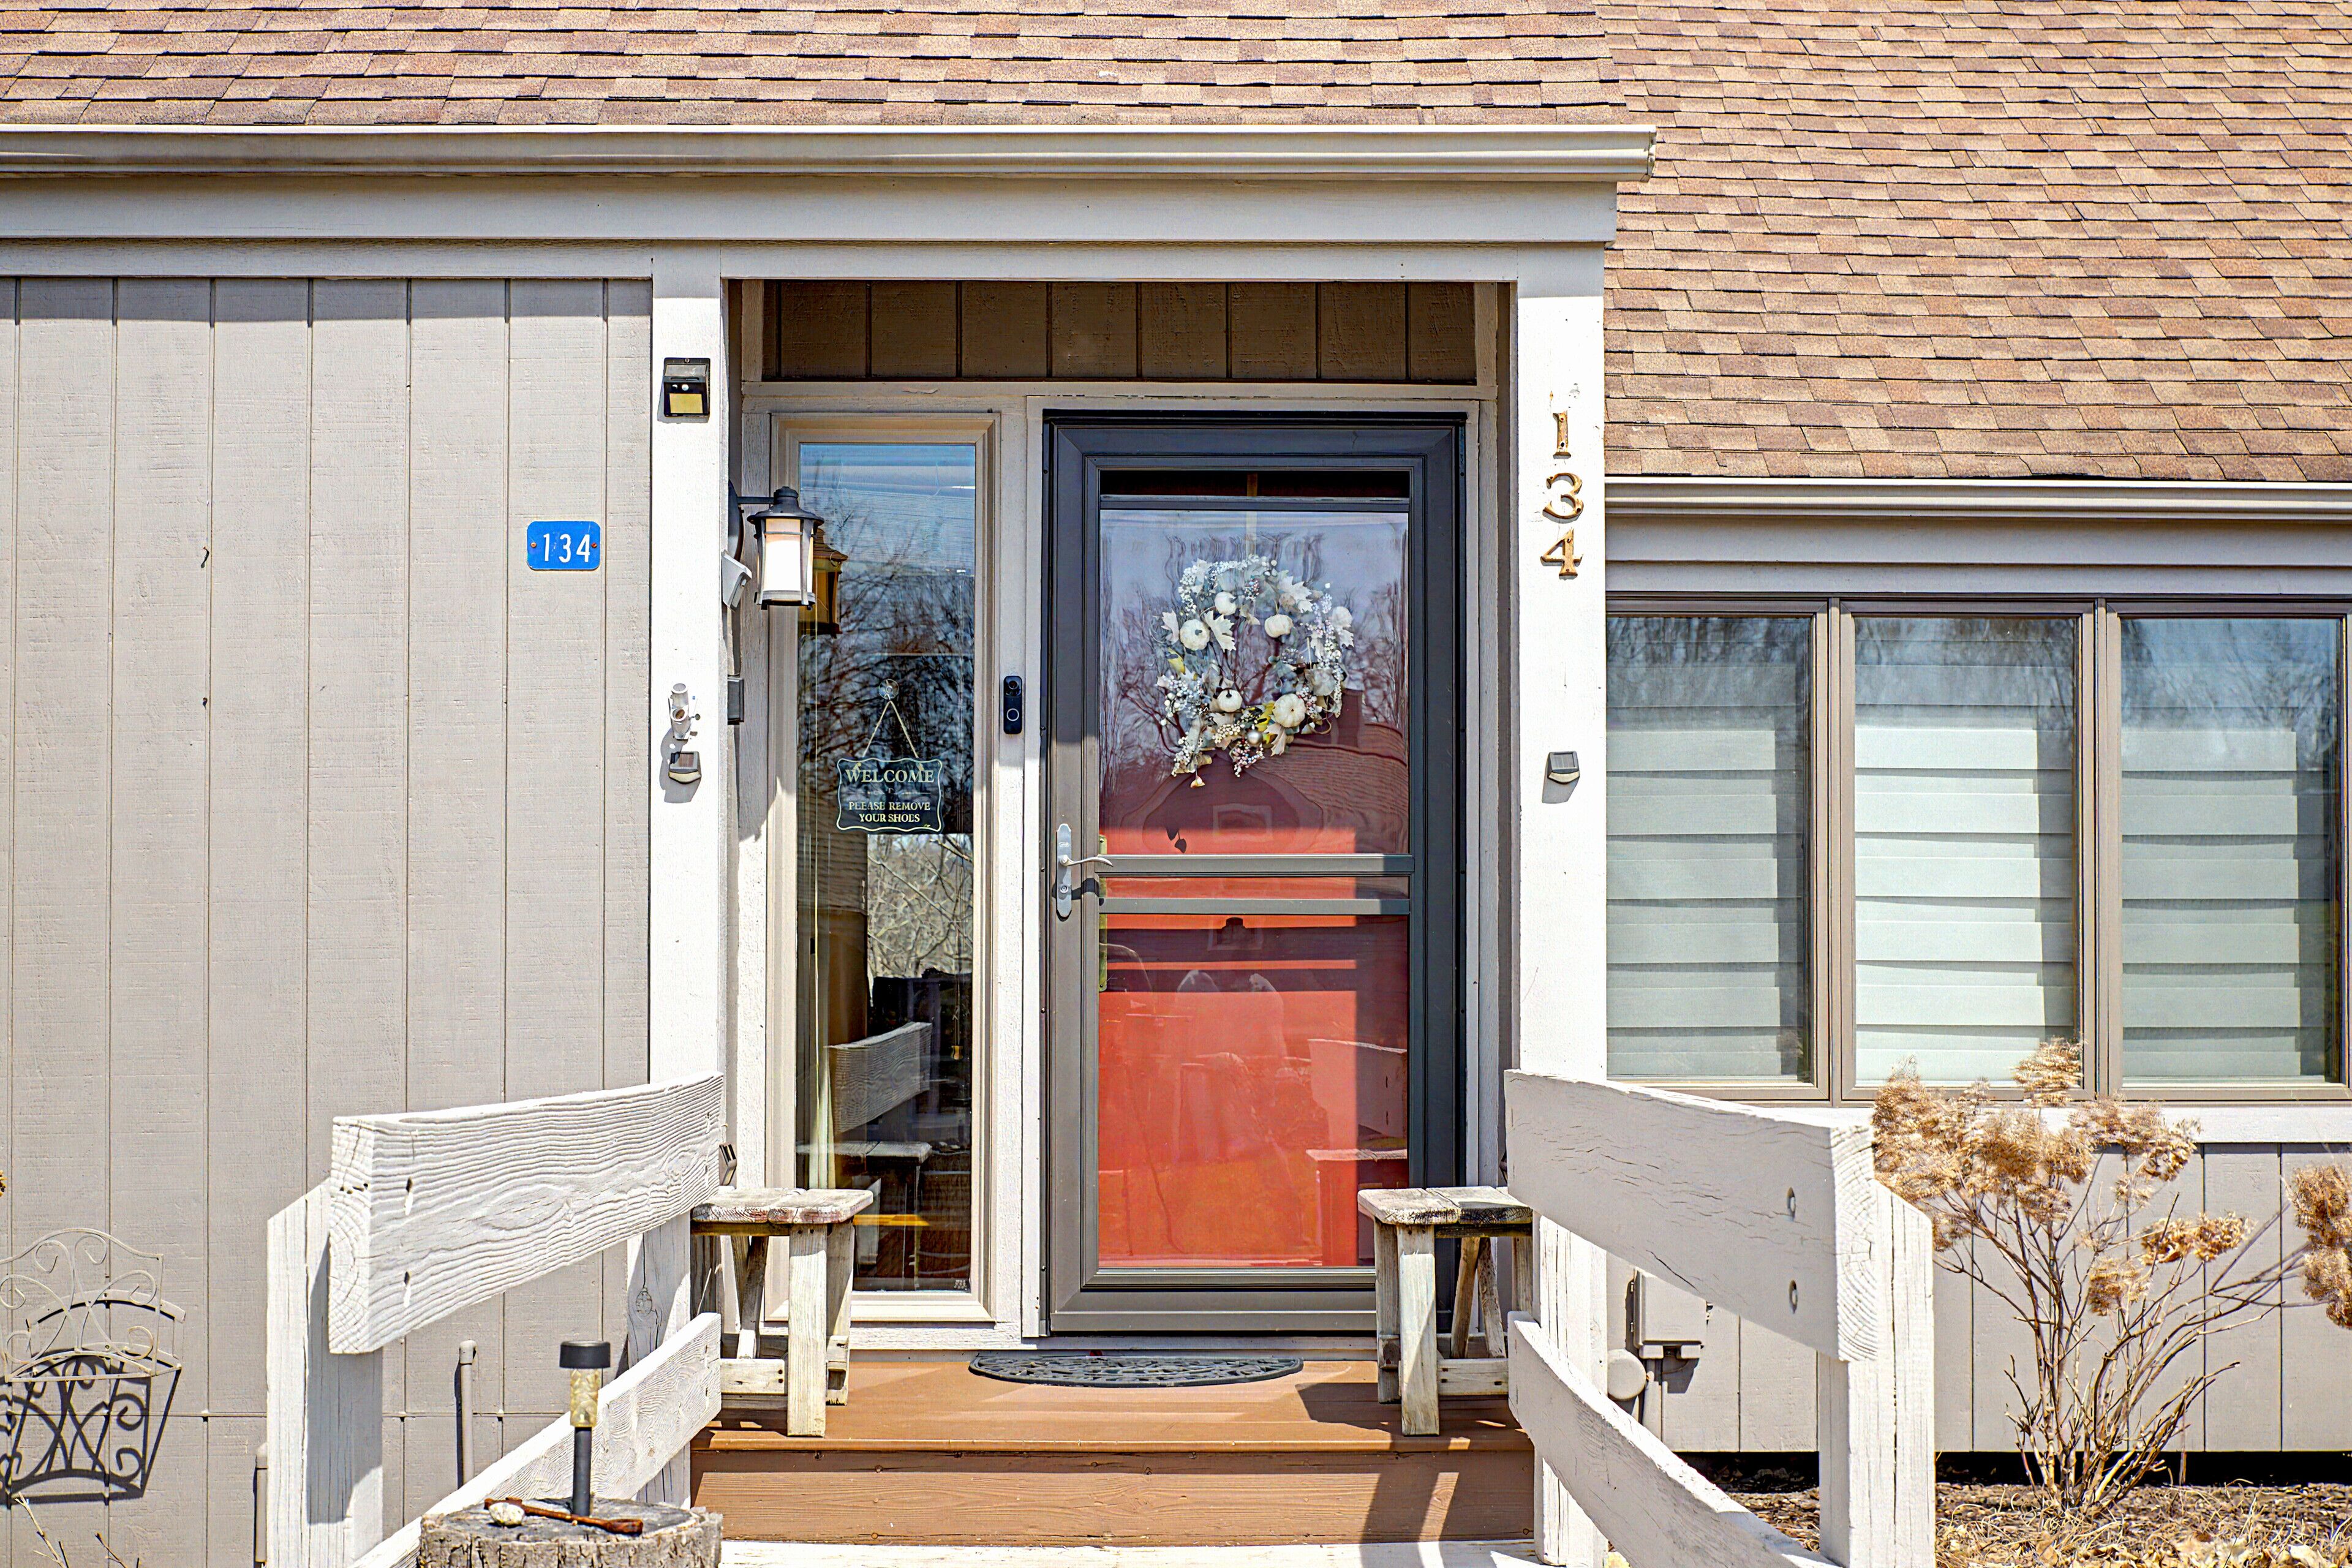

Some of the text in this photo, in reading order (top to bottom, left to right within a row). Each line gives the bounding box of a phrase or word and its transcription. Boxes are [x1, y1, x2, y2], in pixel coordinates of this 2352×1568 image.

[1540, 410, 1584, 580] 134
[543, 533, 590, 563] 134
[845, 769, 935, 783] WELCOME
[849, 802, 930, 810] PLEASE REMOVE
[888, 813, 920, 823] SHOES
